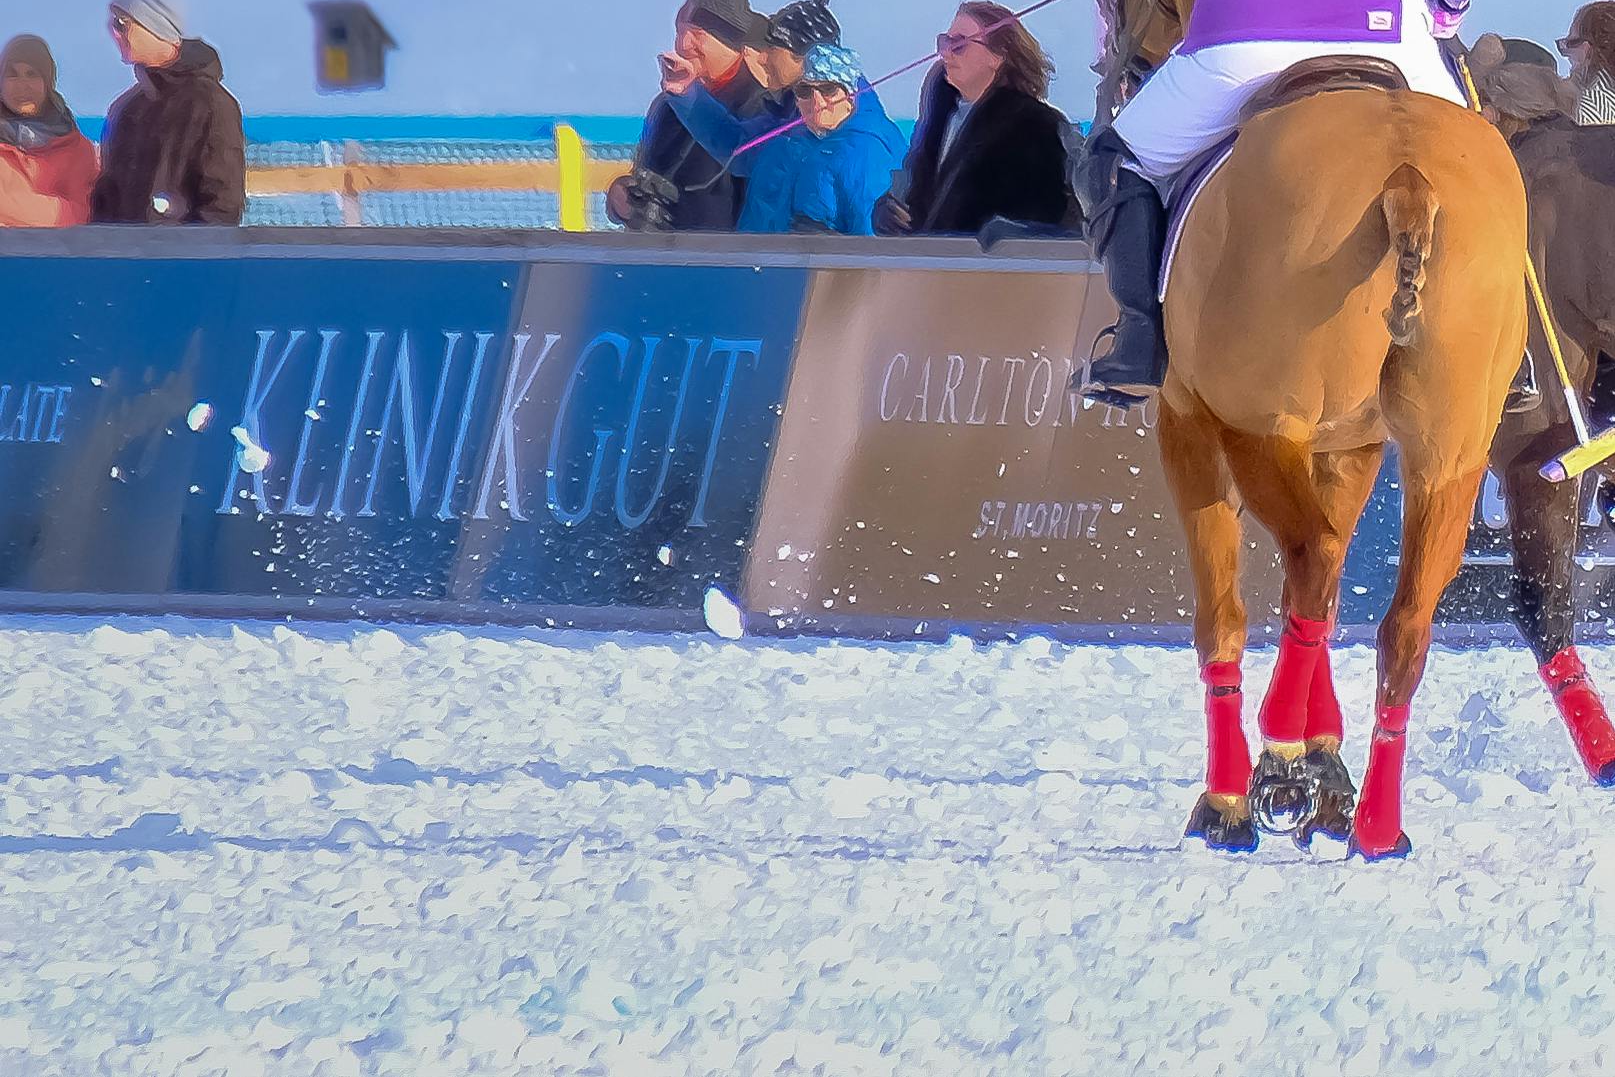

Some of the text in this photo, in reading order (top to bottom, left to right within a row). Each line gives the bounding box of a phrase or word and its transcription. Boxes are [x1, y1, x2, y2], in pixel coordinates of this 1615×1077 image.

[215, 329, 763, 529] KLINIK GUT
[1011, 502, 1102, 540] MORITZ
